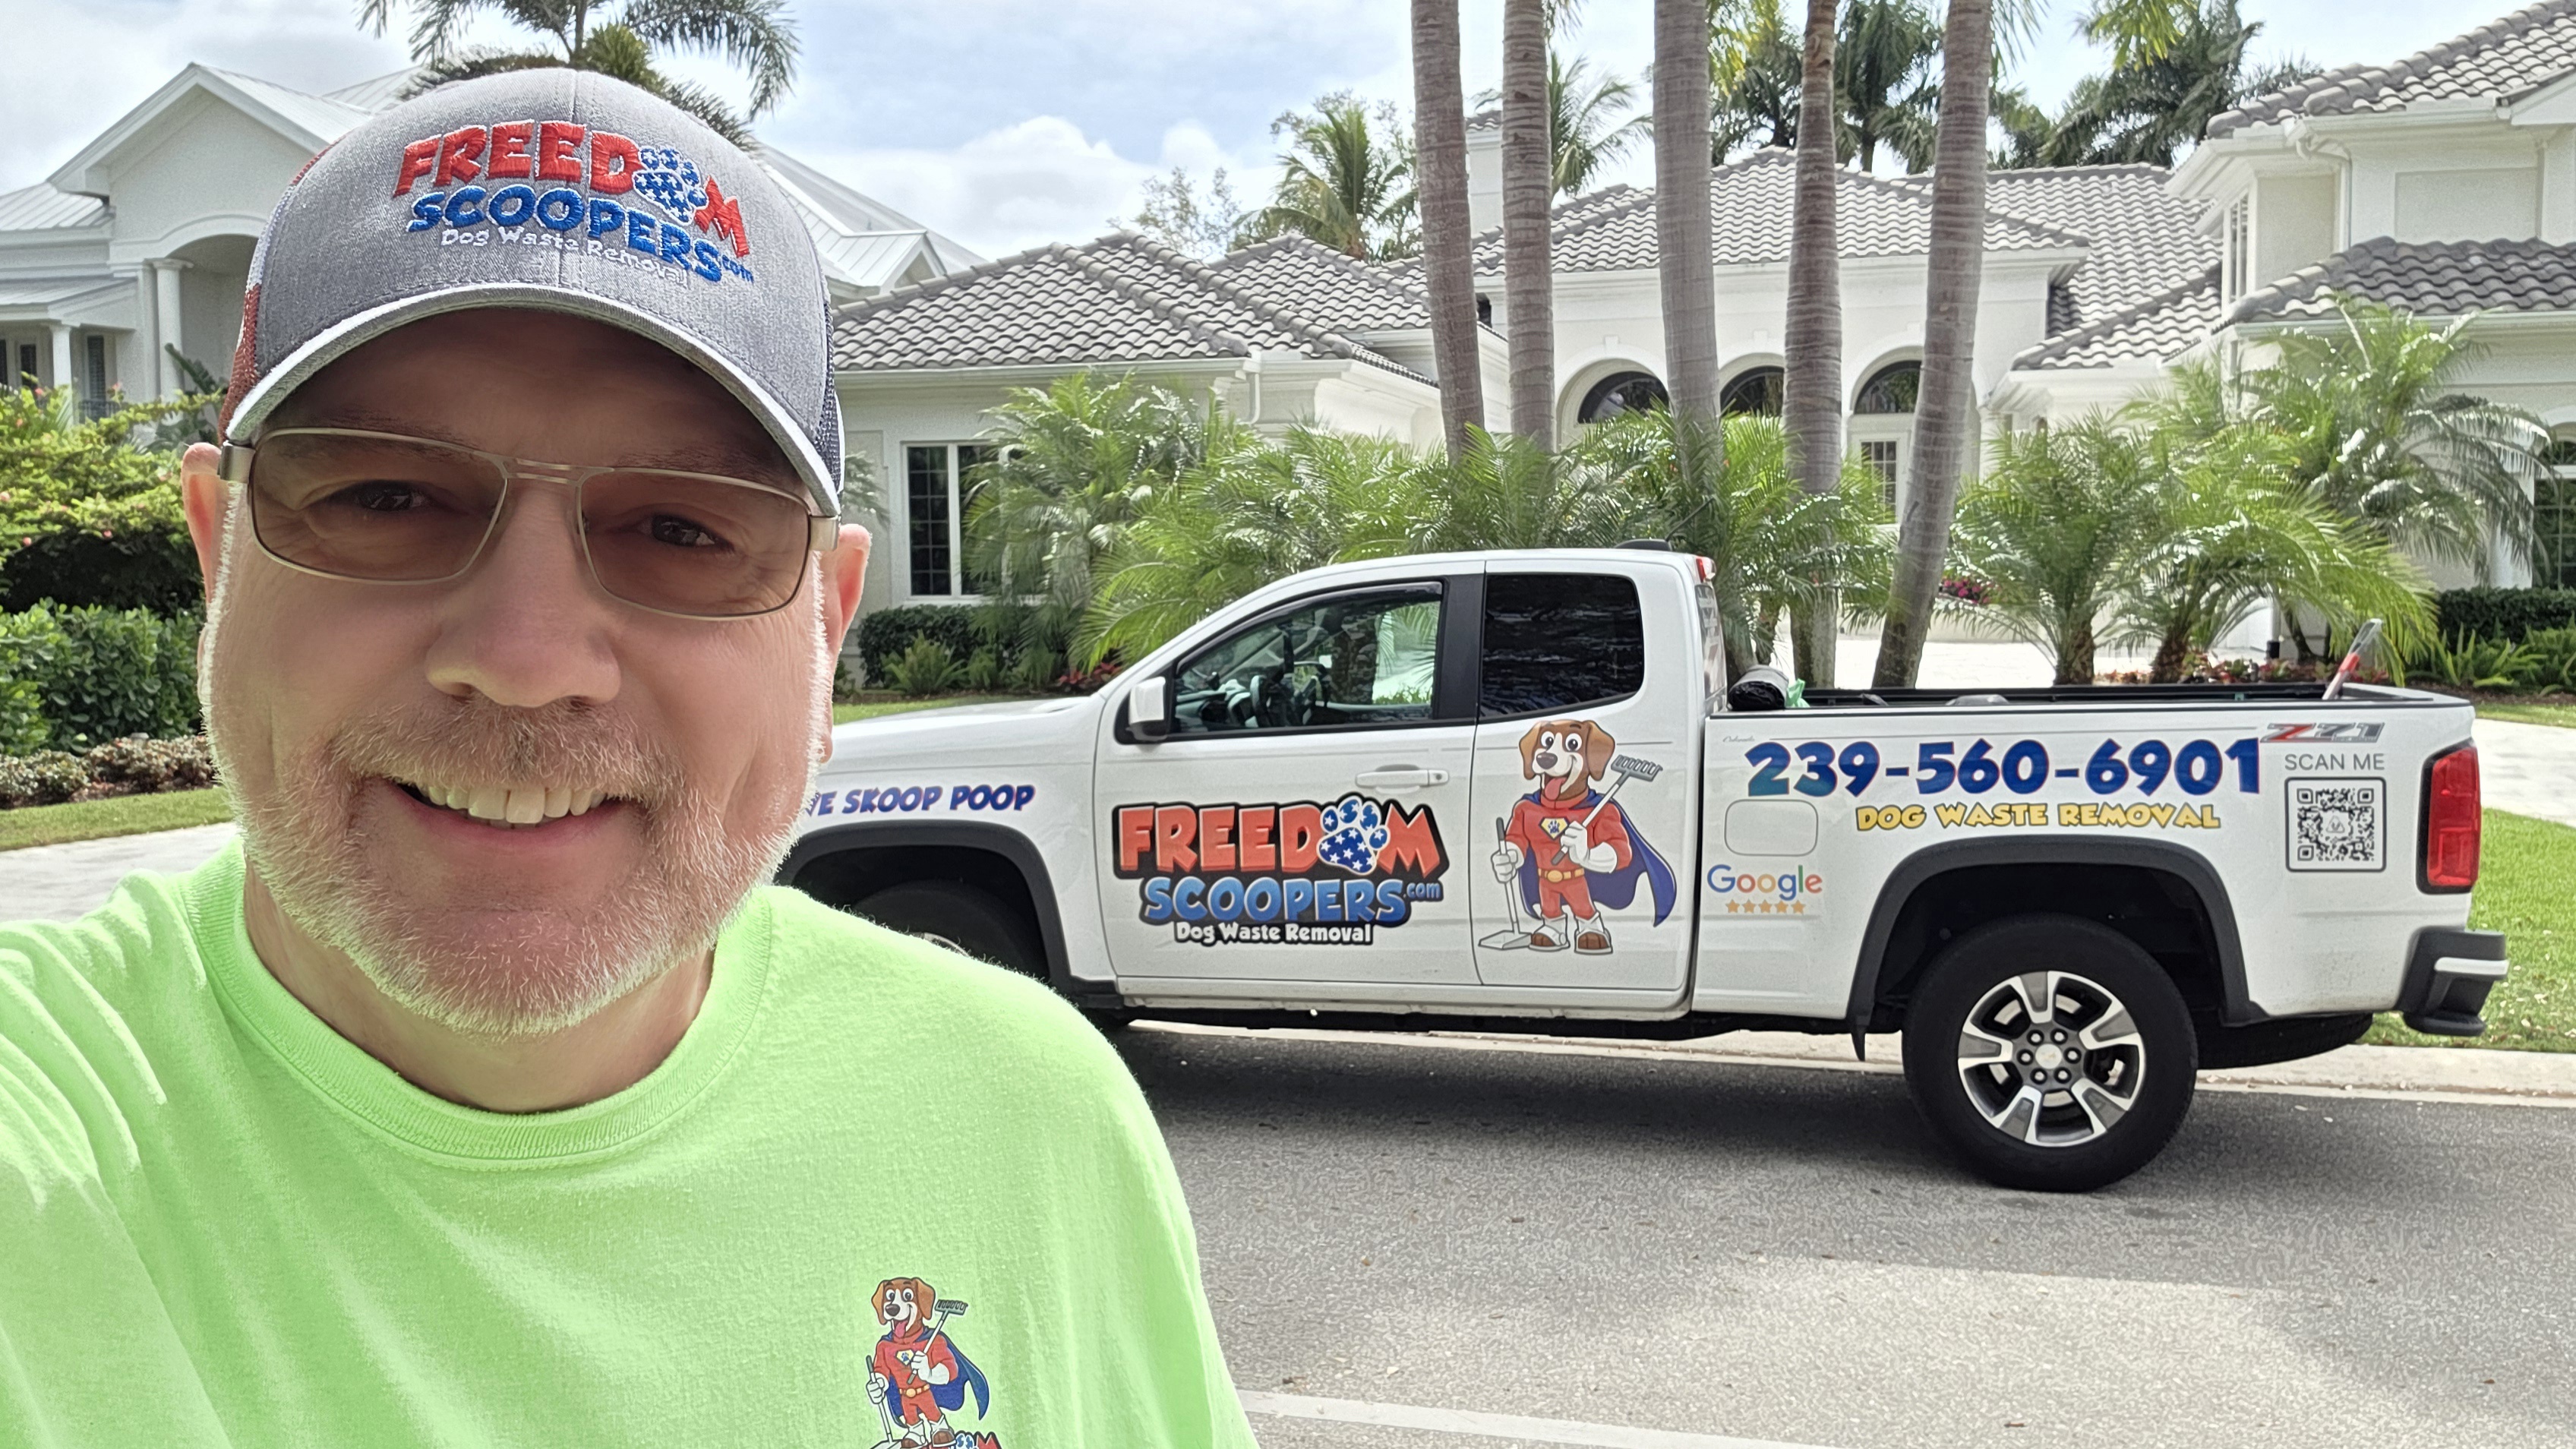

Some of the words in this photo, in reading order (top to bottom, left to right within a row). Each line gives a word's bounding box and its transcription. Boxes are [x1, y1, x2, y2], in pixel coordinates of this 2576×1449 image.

[440, 229, 490, 247] Dog
[497, 226, 579, 251] Waste
[586, 238, 687, 283] Removal
[2260, 722, 2385, 743] Z71
[1744, 737, 2260, 797] 239-560-6901
[2284, 753, 2345, 771] SCAN
[2353, 753, 2385, 770] ME
[841, 785, 942, 814] SKOOP
[949, 784, 1036, 812] POOP
[1855, 803, 1927, 832] DOG
[1934, 801, 2048, 829] WASTE
[2057, 801, 2221, 829] REMOVAL
[1706, 863, 1823, 901] Google
[1175, 922, 1216, 944] Dog
[1218, 922, 1281, 942] Waste
[1284, 923, 1372, 943] Removal
